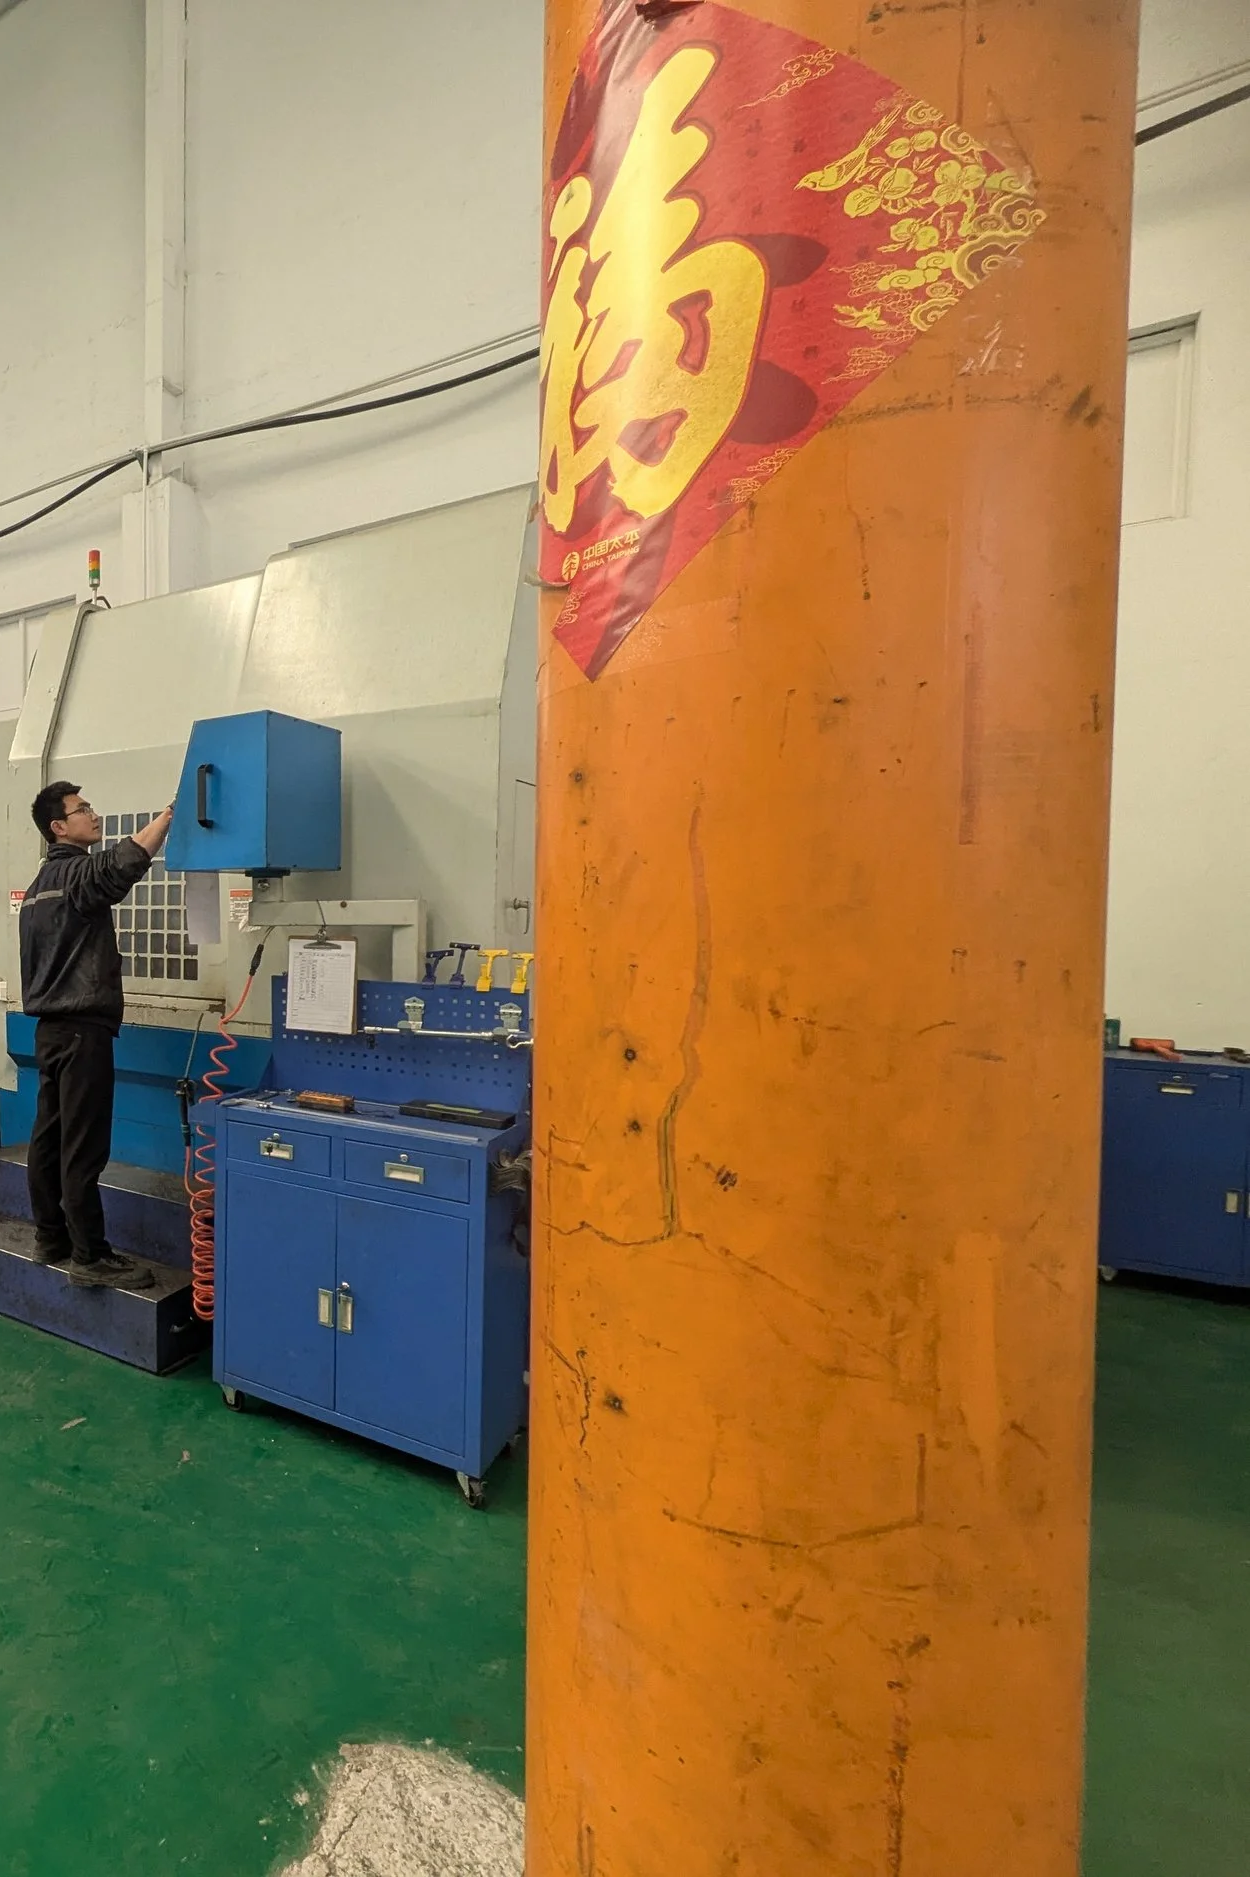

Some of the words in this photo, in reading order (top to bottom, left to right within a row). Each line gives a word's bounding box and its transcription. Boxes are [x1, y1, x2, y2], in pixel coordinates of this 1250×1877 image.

[540, 46, 765, 533] 福
[582, 558, 605, 571] CHINA
[606, 545, 640, 563] TAIPING
[583, 529, 640, 561] 中国太平
